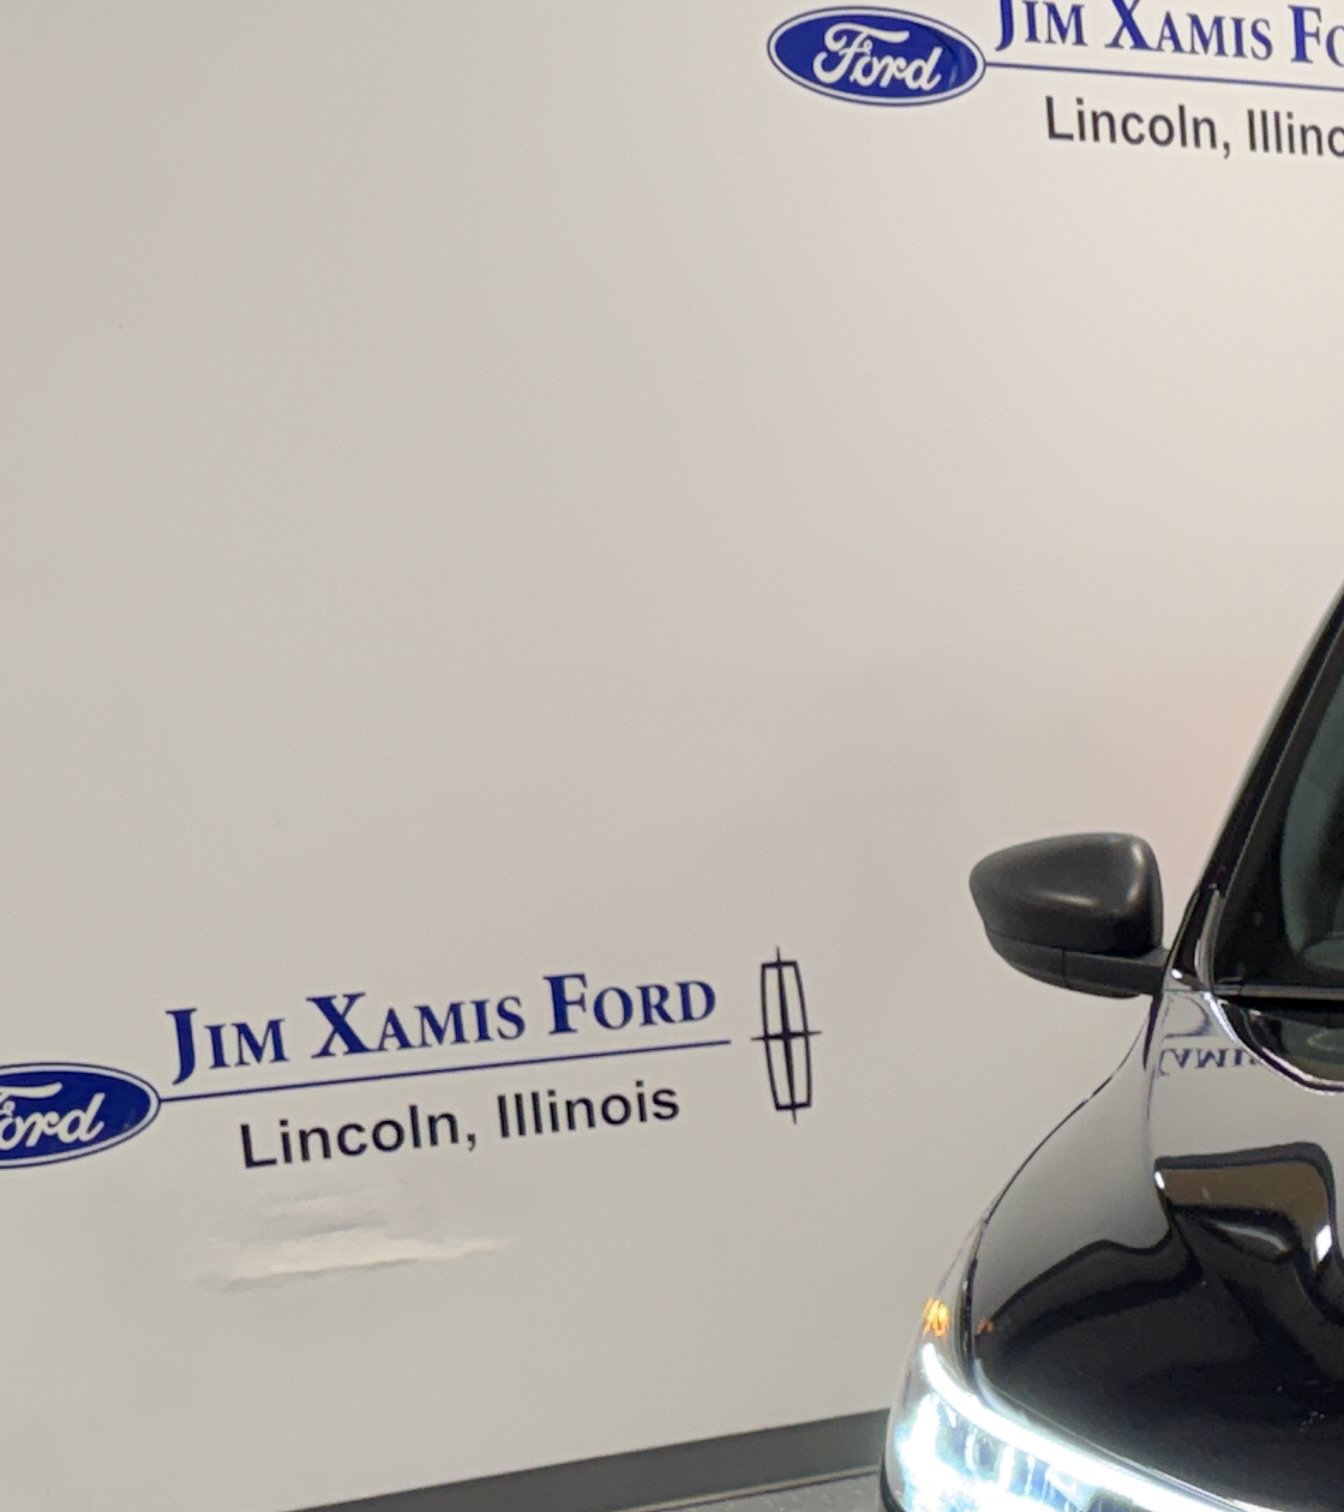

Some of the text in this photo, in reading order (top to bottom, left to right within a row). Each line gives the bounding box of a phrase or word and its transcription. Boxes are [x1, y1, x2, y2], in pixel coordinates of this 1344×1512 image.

[813, 22, 943, 92] Ford
[996, 0, 1088, 51] JIM
[1105, 0, 1274, 60] XAMIS
[1045, 97, 1231, 158] Lincoln,
[166, 972, 716, 1085] JIM XAMIS FORD
[240, 1081, 681, 1168] Lincoln, Illinois
